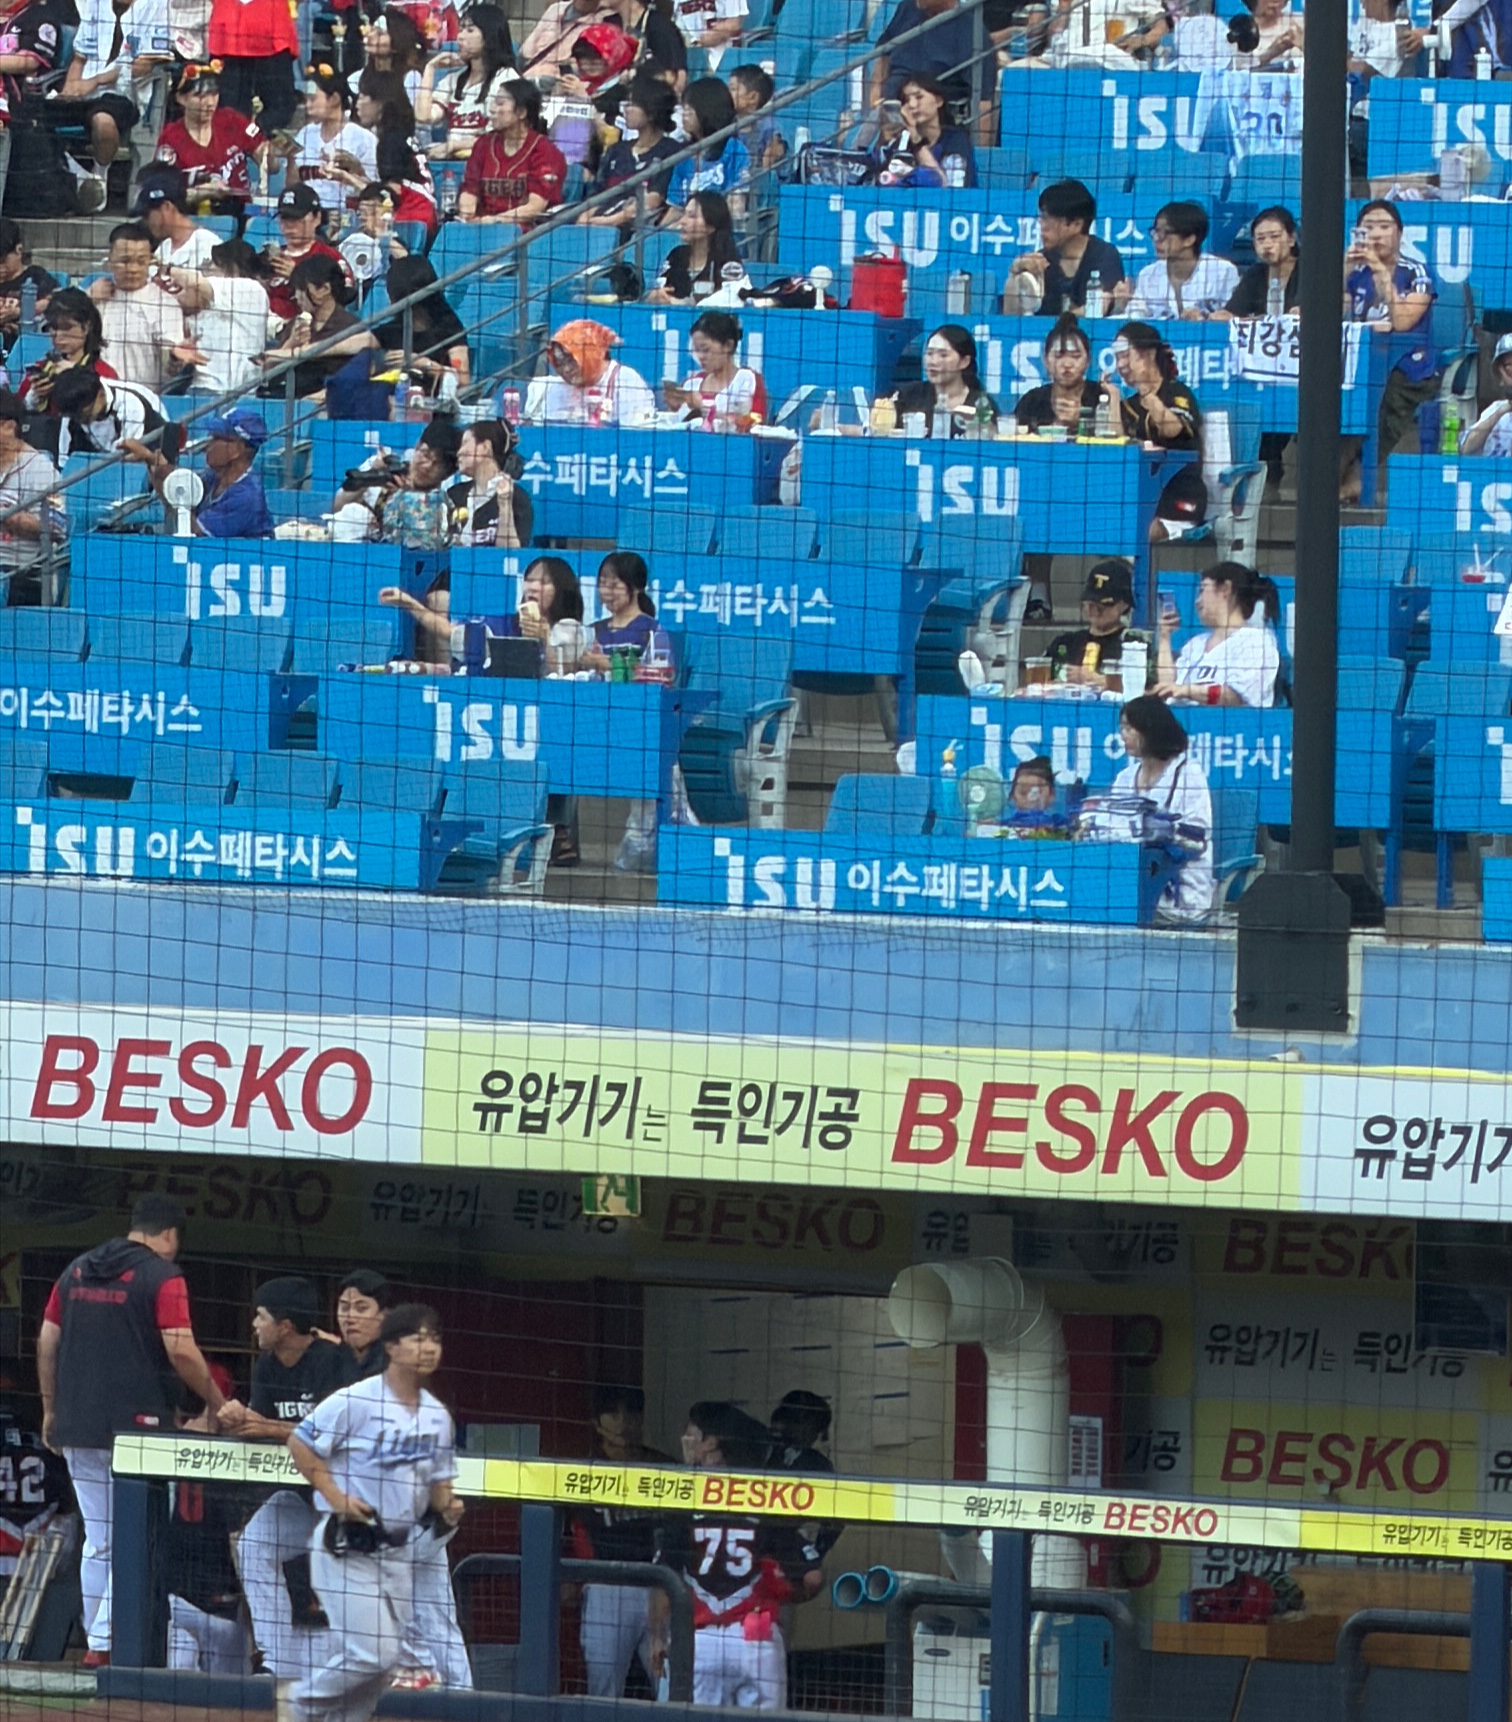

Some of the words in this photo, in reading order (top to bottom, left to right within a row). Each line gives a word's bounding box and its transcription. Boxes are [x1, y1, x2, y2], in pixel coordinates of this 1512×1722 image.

[521, 451, 689, 500] 수페타시스
[0, 687, 203, 736] 이수페타시스
[146, 828, 358, 880] 이수페타시스
[846, 857, 1069, 912] 이수페타시스
[30, 1034, 374, 1135] BESKO
[473, 1068, 666, 1144] 유압기기는
[690, 1079, 860, 1153] 득인기공
[891, 1077, 1250, 1182] BESKO
[662, 1189, 887, 1253] BESKO
[1222, 1217, 1414, 1282] BESK
[1204, 1322, 1338, 1374] 유압기기는
[1220, 1427, 1450, 1494] BESKO
[702, 1477, 815, 1512] BESKO
[1102, 1502, 1218, 1537] BESKO
[693, 1526, 756, 1578] 75
